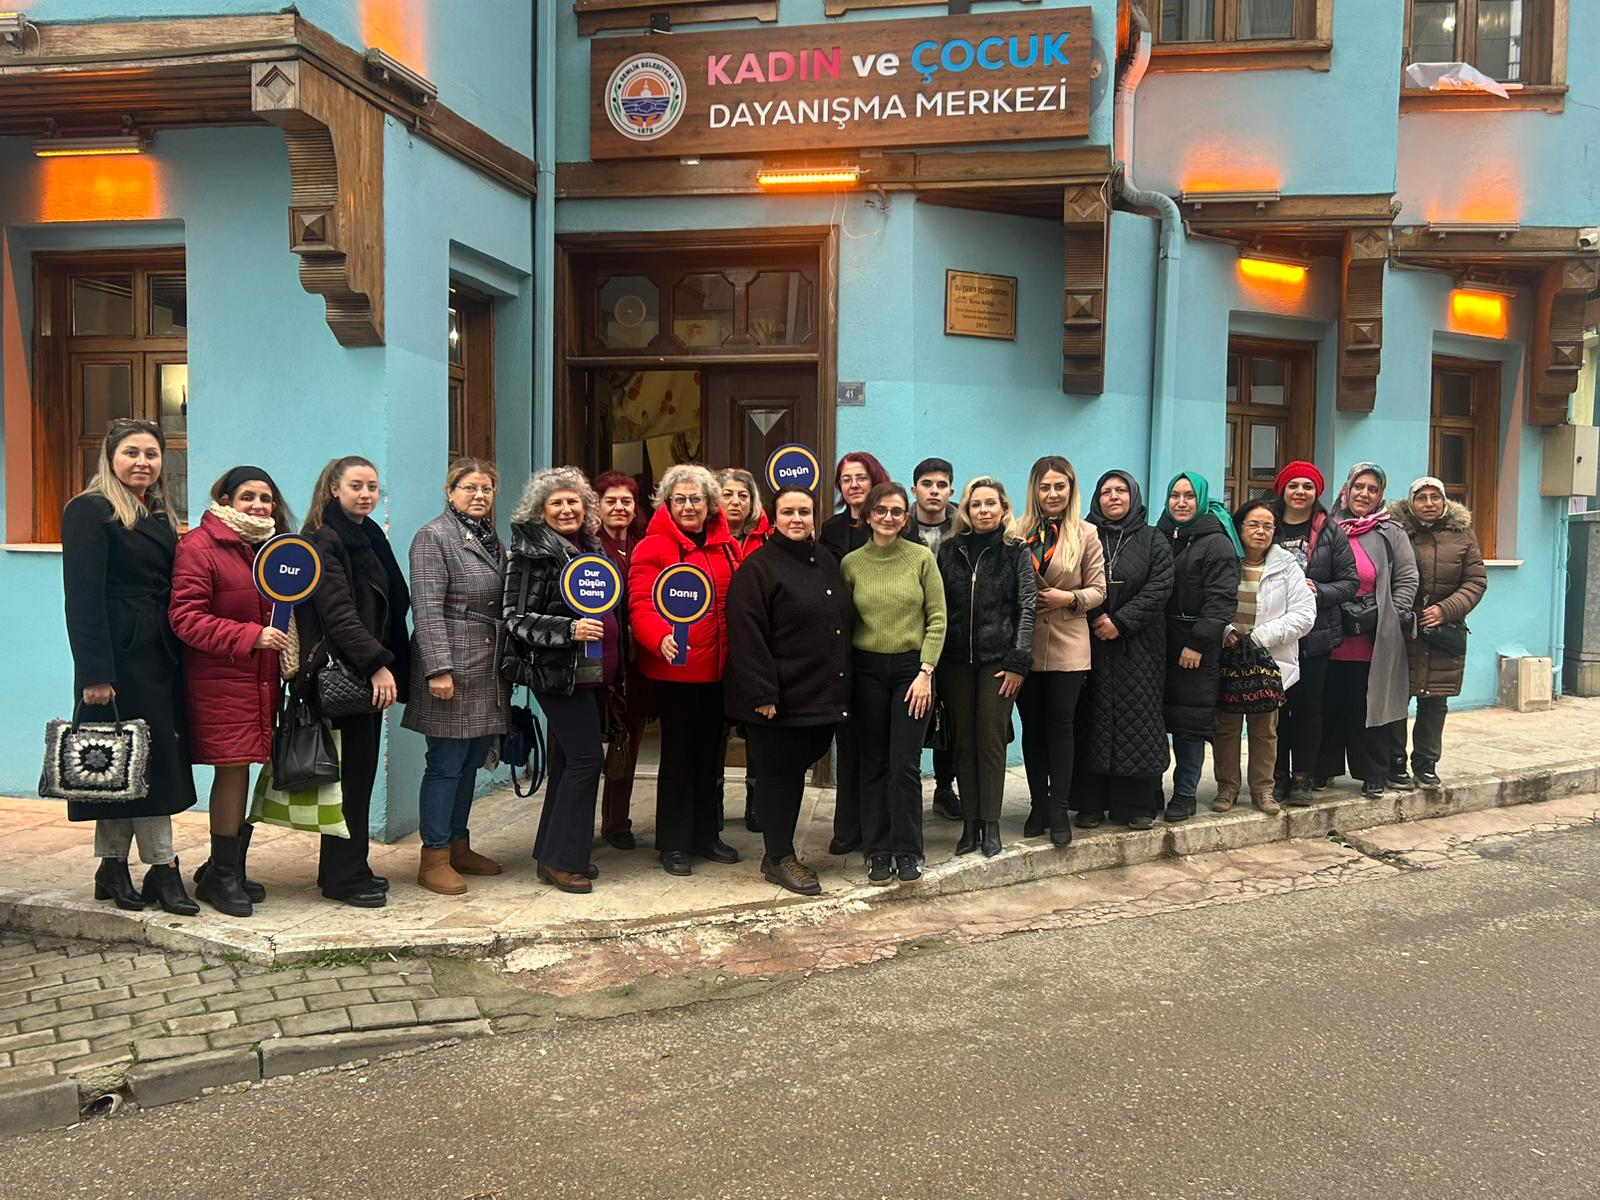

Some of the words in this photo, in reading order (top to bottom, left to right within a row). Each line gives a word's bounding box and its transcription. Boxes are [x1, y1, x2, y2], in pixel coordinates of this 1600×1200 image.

[707, 47, 841, 86] KADIN
[852, 52, 900, 77] ve
[911, 31, 1071, 84] ÇOCUK
[620, 63, 641, 82] GEMLİK
[641, 61, 675, 81] BELEDİYESİ
[709, 93, 907, 130] DAYANIŞMA
[915, 77, 1067, 118] MERKEZİ
[845, 389, 854, 399] 41
[779, 465, 809, 479] Düşün
[279, 564, 301, 576] Dur
[584, 569, 601, 577] Dur
[578, 578, 606, 589] Düşün
[580, 588, 605, 599] Danış
[669, 588, 698, 601] Danış
